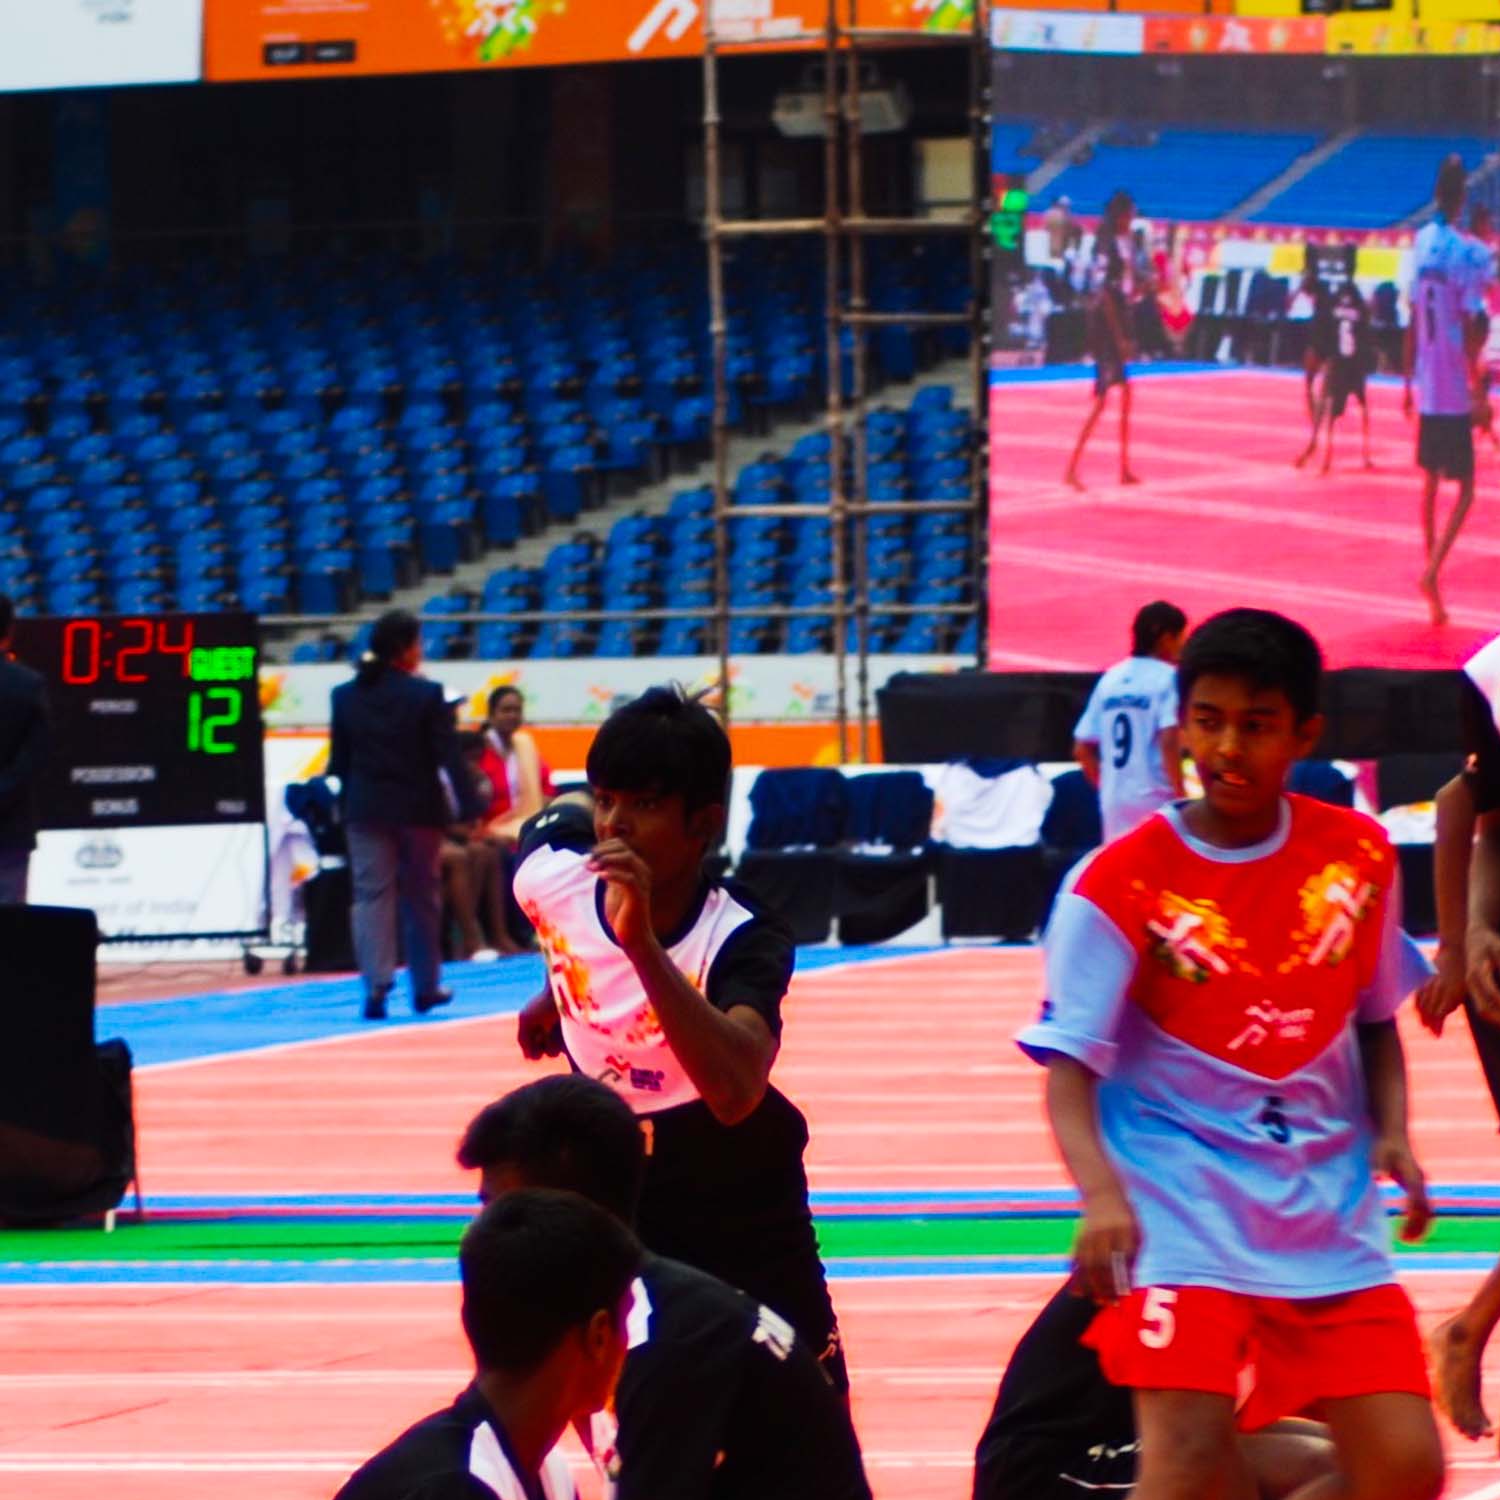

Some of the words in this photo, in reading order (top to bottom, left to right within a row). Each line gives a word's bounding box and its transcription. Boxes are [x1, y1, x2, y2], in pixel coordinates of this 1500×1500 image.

[62, 619, 194, 684] 0:24
[188, 687, 242, 753] 12
[1111, 711, 1133, 769] 9
[1137, 1287, 1179, 1349] 5
